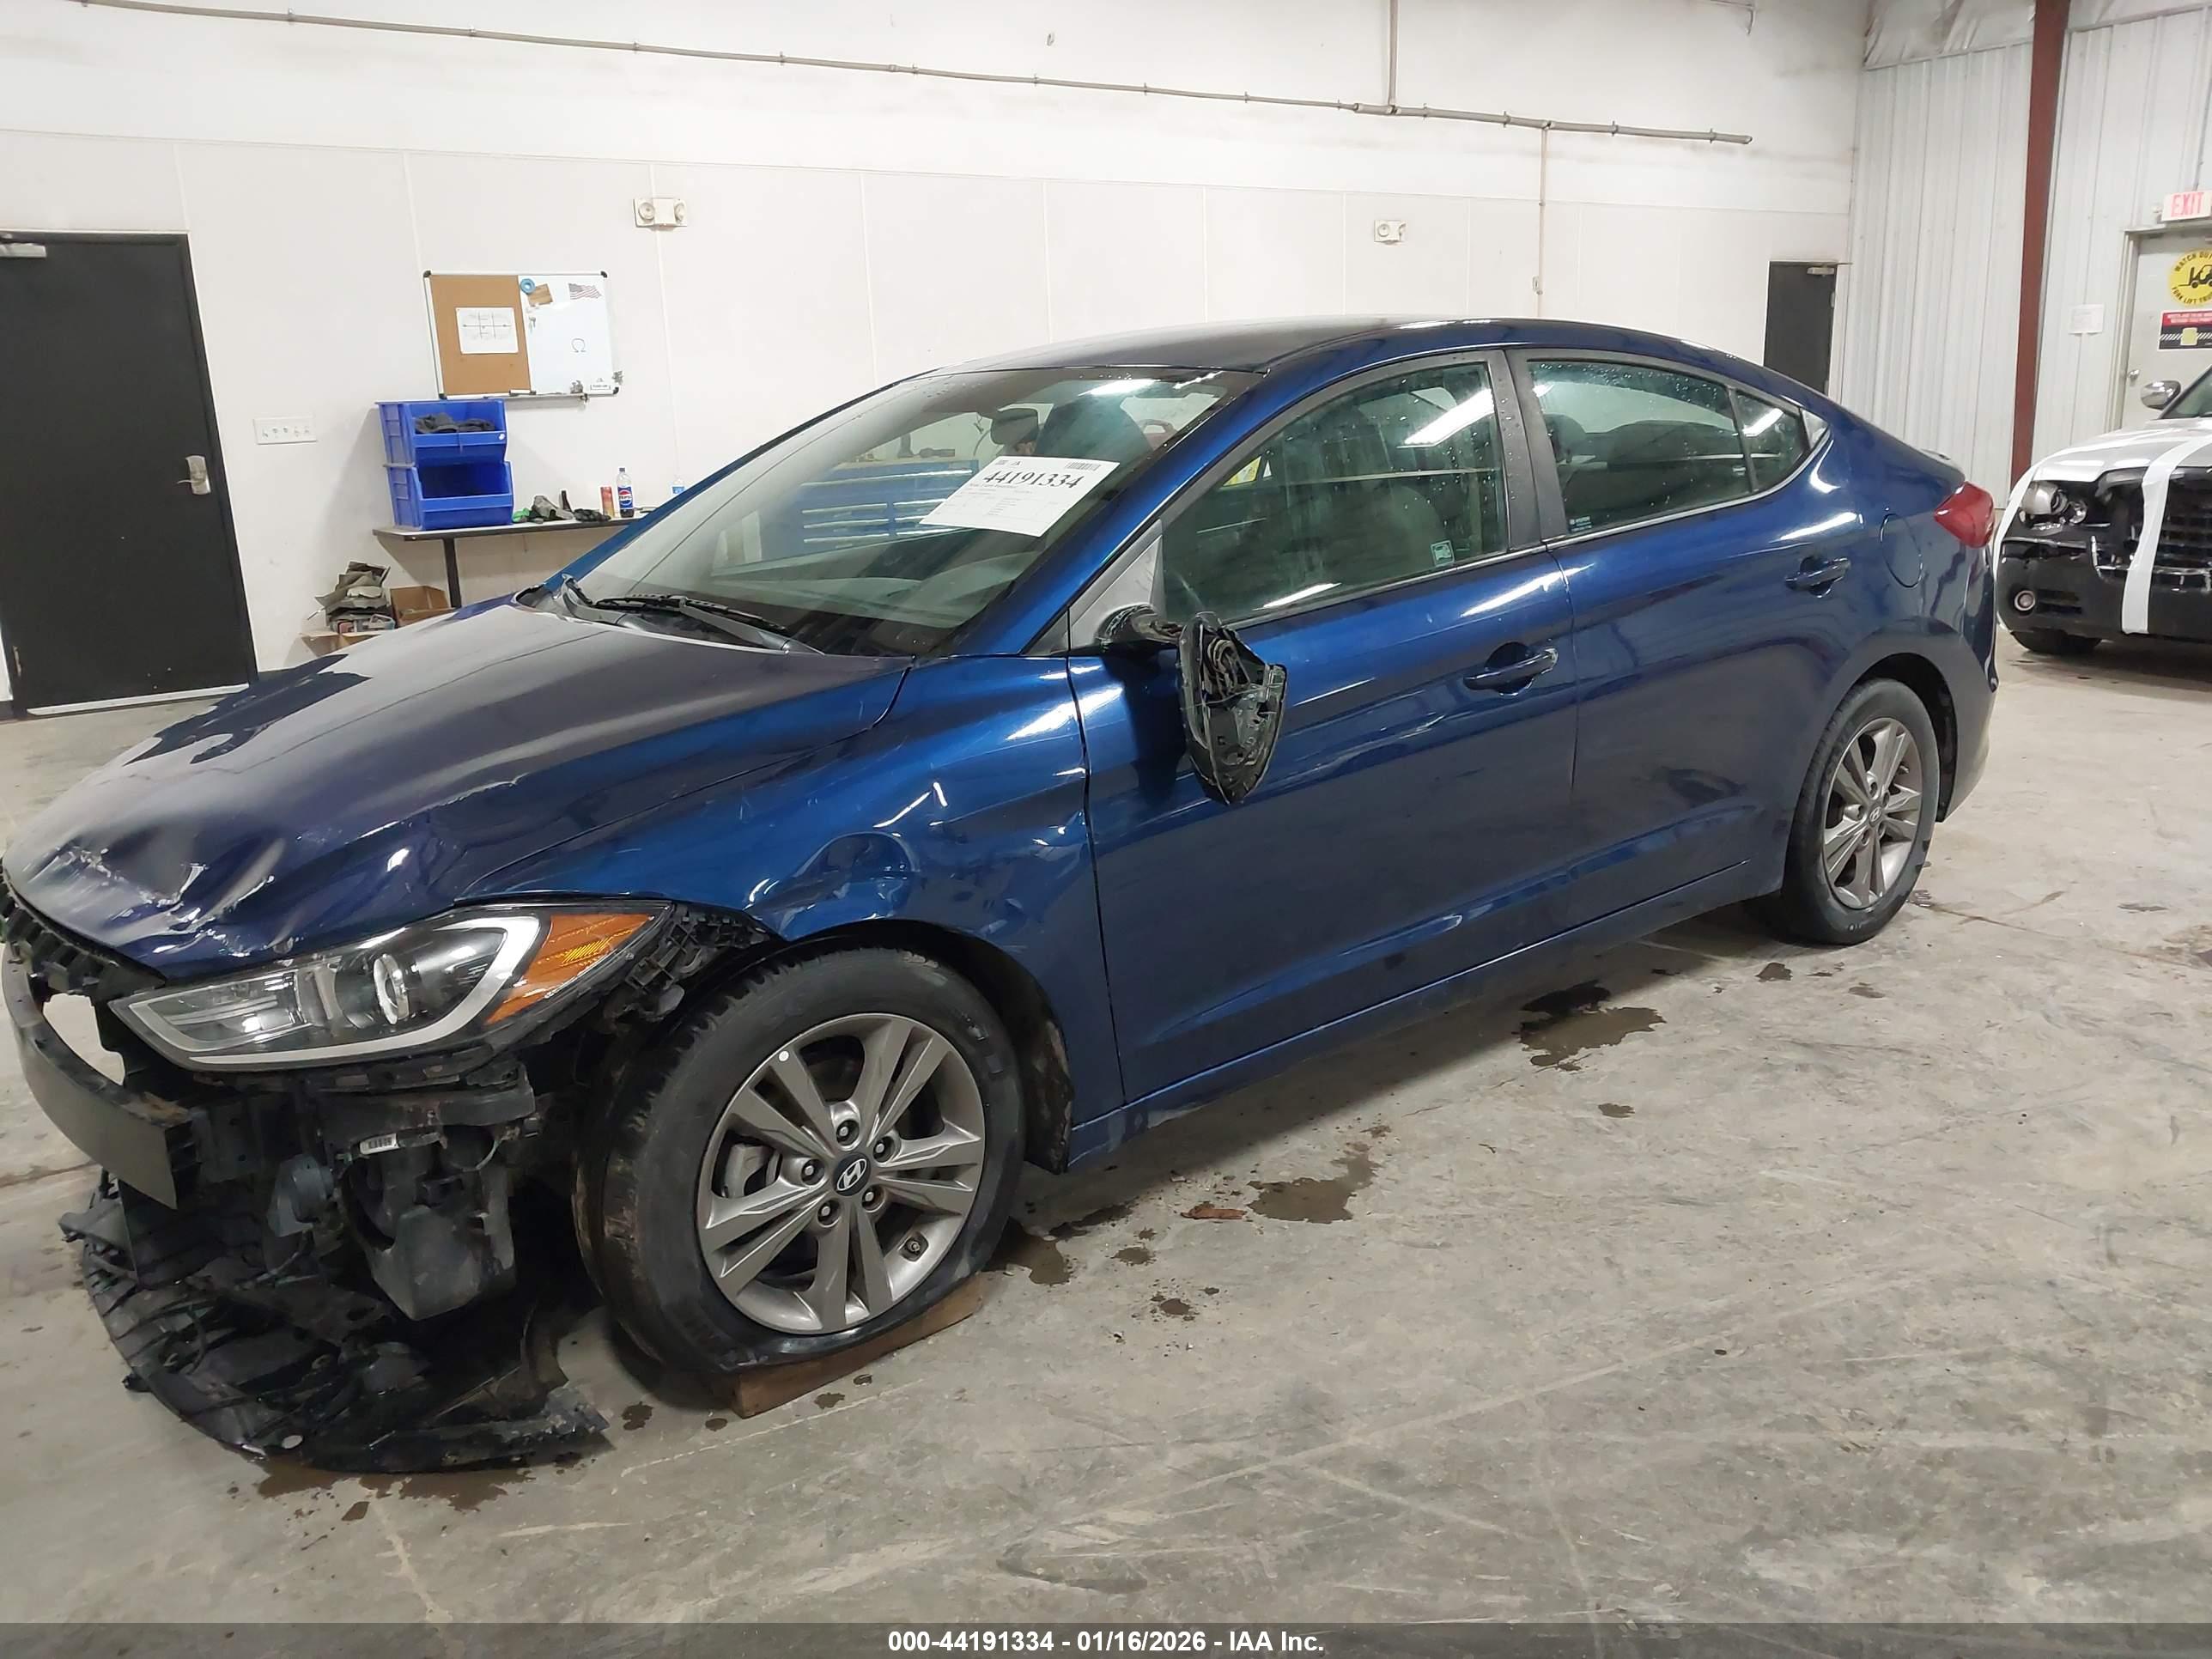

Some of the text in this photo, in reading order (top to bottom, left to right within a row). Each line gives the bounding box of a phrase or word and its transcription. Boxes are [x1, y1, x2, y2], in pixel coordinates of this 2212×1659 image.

[2170, 192, 2204, 217] EXIT
[2174, 252, 2197, 271] WATCH
[984, 470, 1085, 489] 44191334
